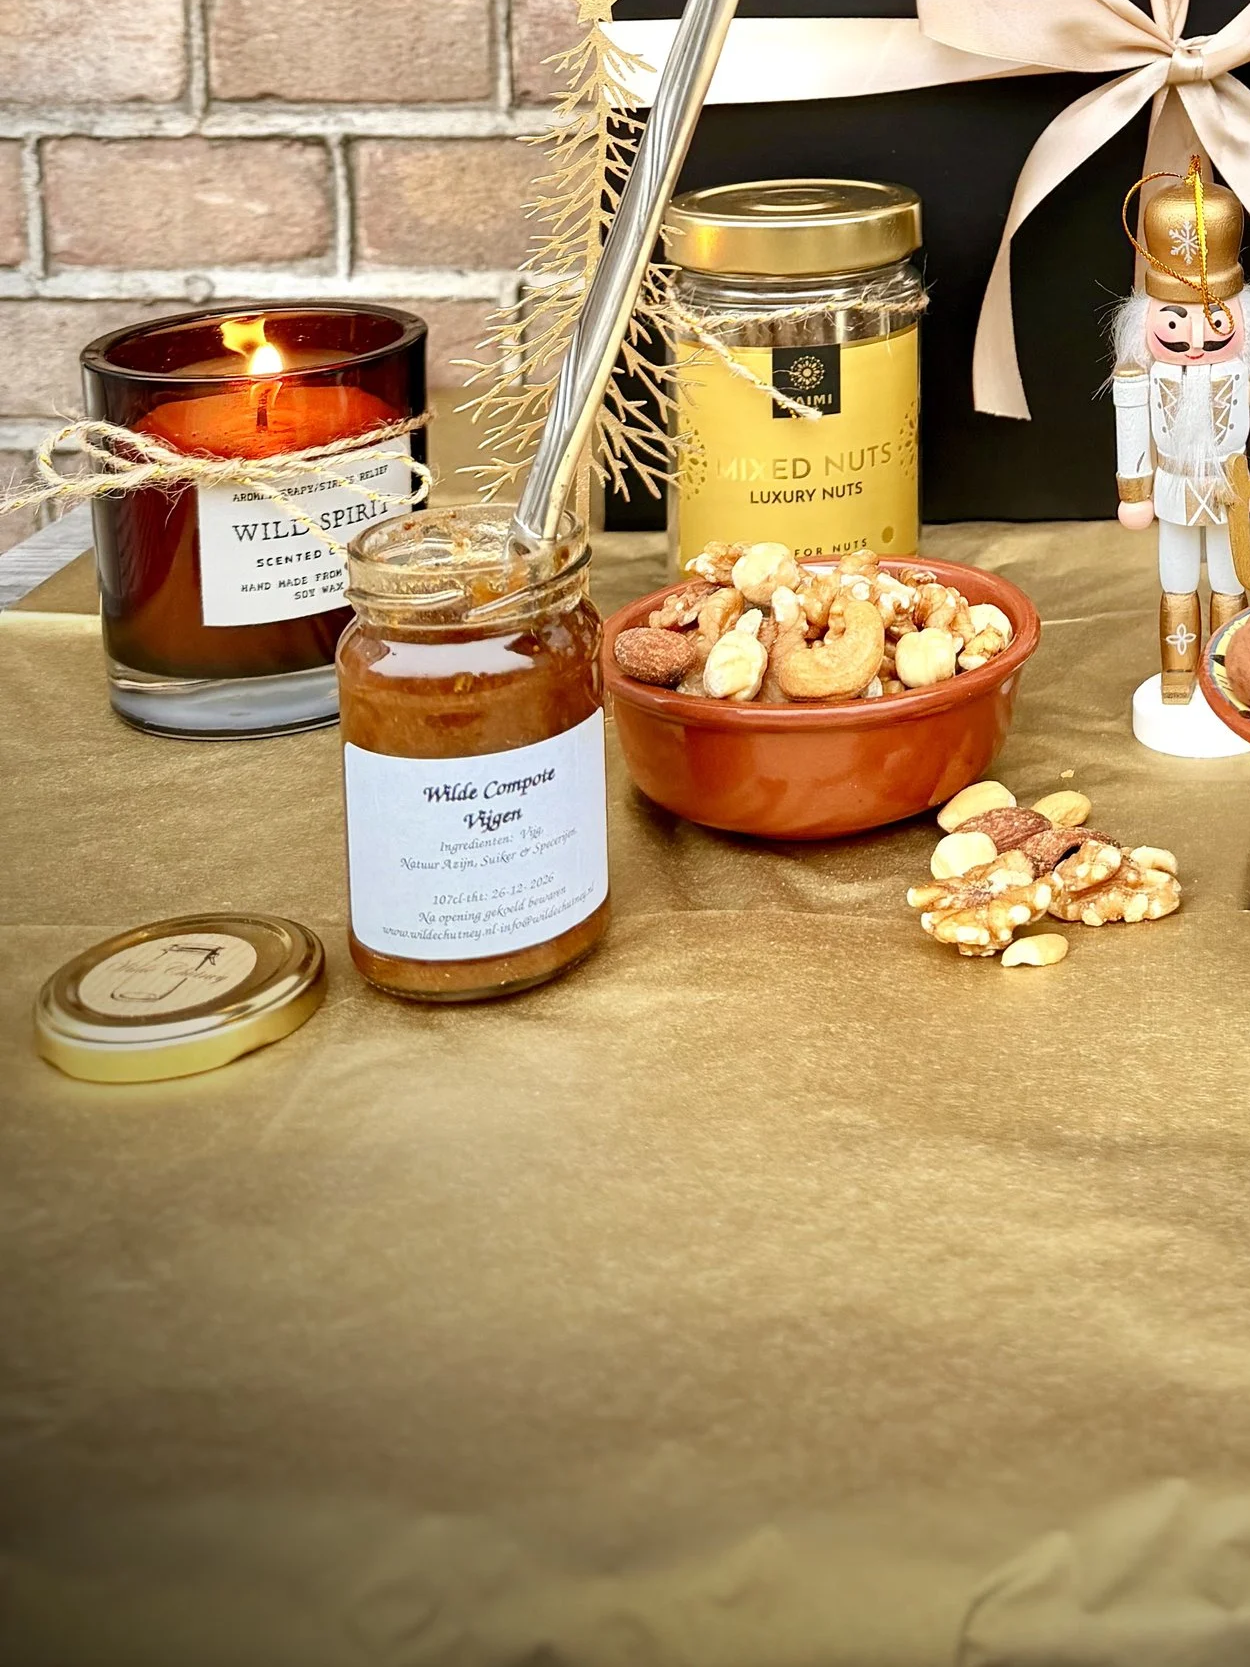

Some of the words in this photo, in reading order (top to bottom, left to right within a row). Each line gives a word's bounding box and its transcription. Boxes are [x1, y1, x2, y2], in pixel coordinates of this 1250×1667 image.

[786, 393, 833, 408] AIMI
[717, 457, 811, 481] MIXED
[825, 442, 891, 476] NUTS
[359, 465, 388, 482] RELIEF
[750, 488, 816, 504] LUXURY
[822, 481, 863, 501] NUTS
[320, 498, 389, 531] SPIRIT
[256, 549, 322, 568] SCENTED
[793, 548, 823, 557] FOR
[832, 538, 868, 553] NUTS
[240, 581, 272, 593] HAND
[278, 576, 308, 588] MADE
[315, 568, 343, 582] FROM
[294, 588, 316, 600] SOY
[322, 581, 344, 593] WAX
[423, 782, 478, 803] Wilde
[483, 767, 556, 799] Compote
[463, 806, 523, 833] Vijgen
[439, 834, 514, 855] Ingredienten:
[400, 856, 441, 871] Natuur
[442, 857, 478, 872] Azijn,
[480, 851, 517, 867] Suiker
[519, 846, 532, 857] &
[529, 871, 556, 891] 2026
[418, 912, 437, 924] Na
[438, 909, 482, 926] opening
[483, 899, 525, 922] gekoeld
[527, 885, 567, 909] bewaren
